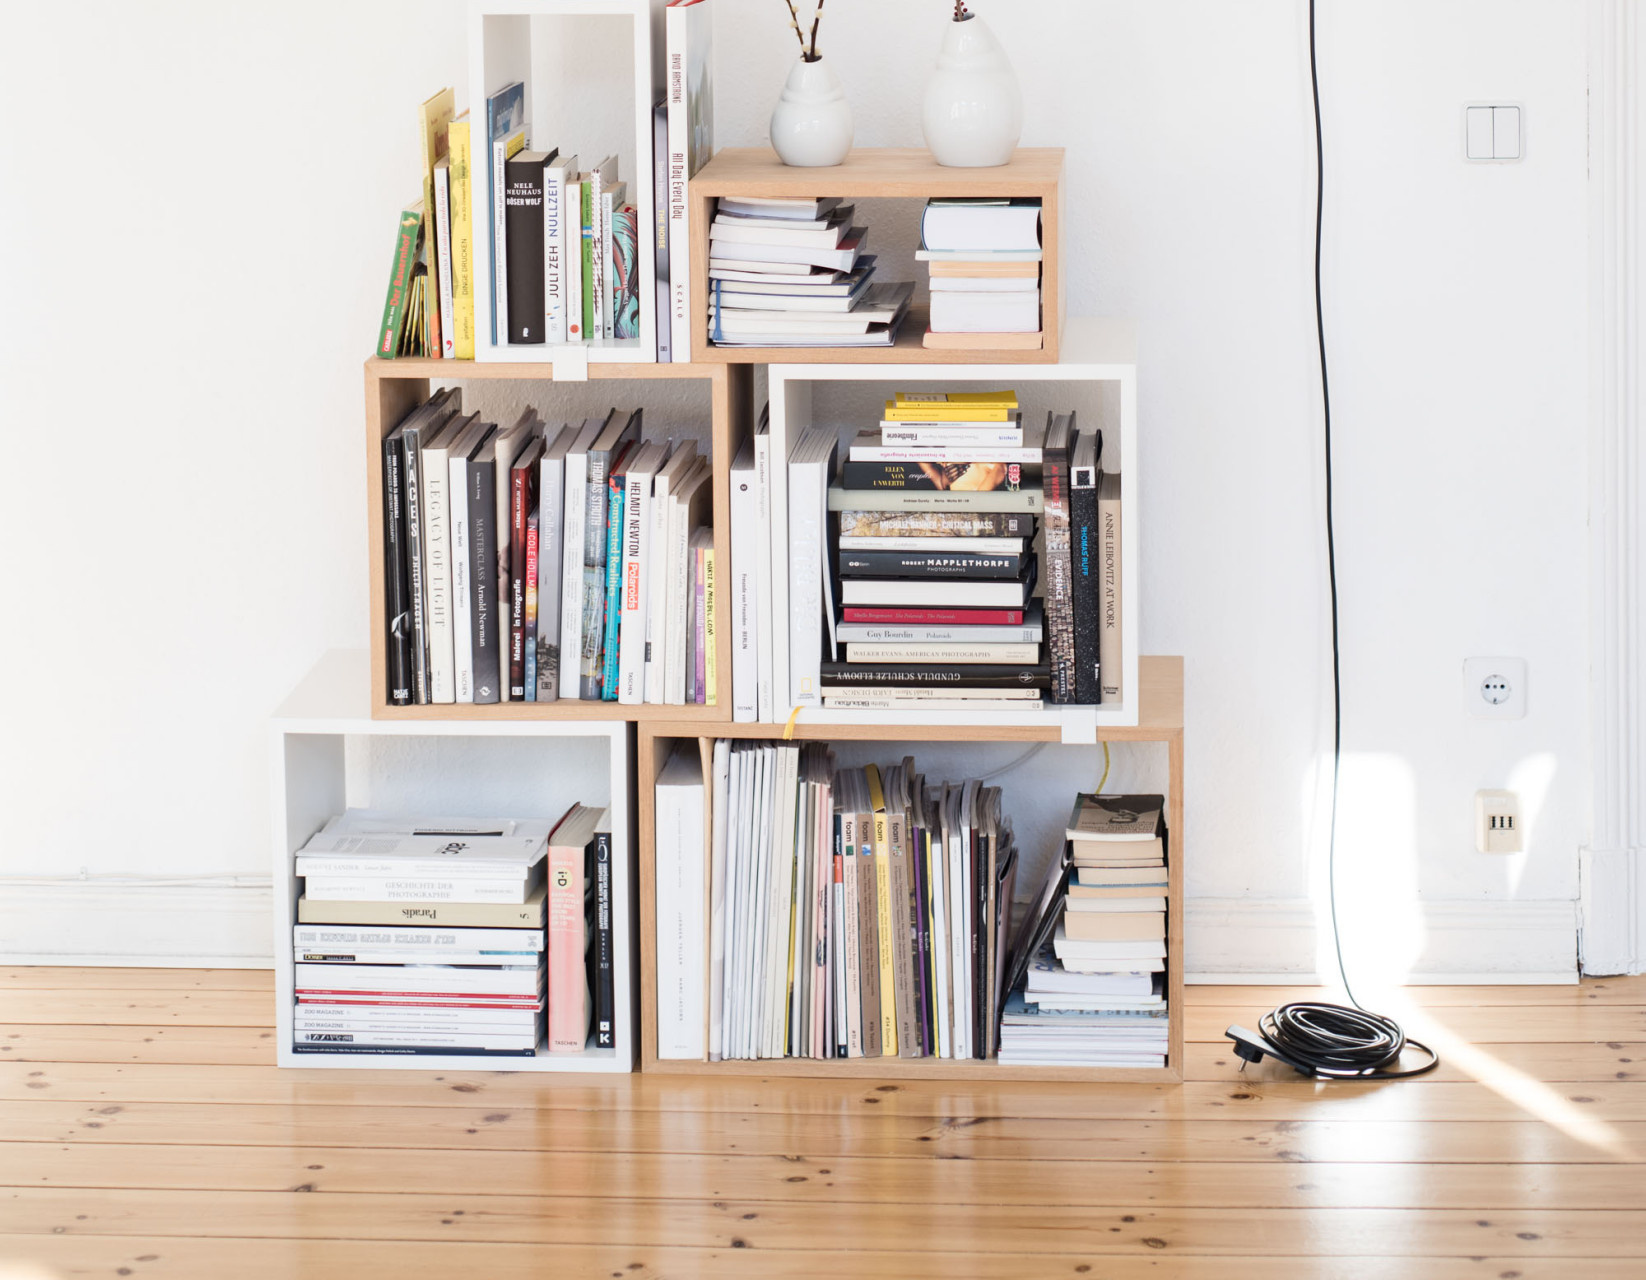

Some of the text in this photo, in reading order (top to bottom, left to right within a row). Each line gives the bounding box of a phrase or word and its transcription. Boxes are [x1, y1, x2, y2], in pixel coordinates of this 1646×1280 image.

[506, 188, 542, 196] NEUHAUS
[669, 152, 684, 220] All Day Every Day
[506, 197, 542, 206] BÖSER WOLF
[657, 209, 665, 225] THE
[547, 178, 559, 299] JULI ZEH NULLZEIT
[657, 226, 665, 249] NOISE
[393, 233, 412, 287] Bauernhof
[460, 238, 469, 295] DINGE DRUCKEN
[389, 288, 402, 307] Der
[886, 432, 917, 440] Filmtheorie
[407, 450, 418, 538] FACES
[590, 461, 604, 526] THOMAS STRUTH
[544, 479, 554, 550] Harry Callahan
[629, 481, 641, 557] HELMUT NEWTON
[942, 521, 994, 530] CRITICAL MASS
[476, 518, 485, 581] MASTERCLASS
[527, 524, 536, 557] NICOLE
[608, 494, 622, 597] Constructed Realities
[1080, 526, 1089, 576] THOMAS RUFF
[430, 480, 445, 627] LEGACY OF LIGHT
[927, 558, 1010, 567] MAPPLETHORPE
[1054, 559, 1064, 601] EVIDENCE
[1105, 512, 1115, 629] ANNIE LEIBOVITZ AT WORK
[627, 563, 638, 609] Polaroids
[477, 584, 486, 647] Arnold Newman
[513, 579, 522, 661] Malerei in Fotografie
[867, 630, 913, 640] Guy Bourdin
[926, 632, 952, 640] Polaroids
[940, 651, 991, 659] PHOTOGRAPHS
[836, 671, 961, 680] GUNDULA SCHULZE ELDOWY
[845, 821, 853, 842] foam
[862, 821, 870, 842] foam
[876, 821, 884, 842] foam
[892, 822, 900, 843] foam
[385, 881, 454, 890] GESCHICHTE DER
[387, 890, 451, 899] PHOTOGRAPHIE
[401, 908, 437, 920] Paradis
[316, 1008, 344, 1016] MAGAZINE
